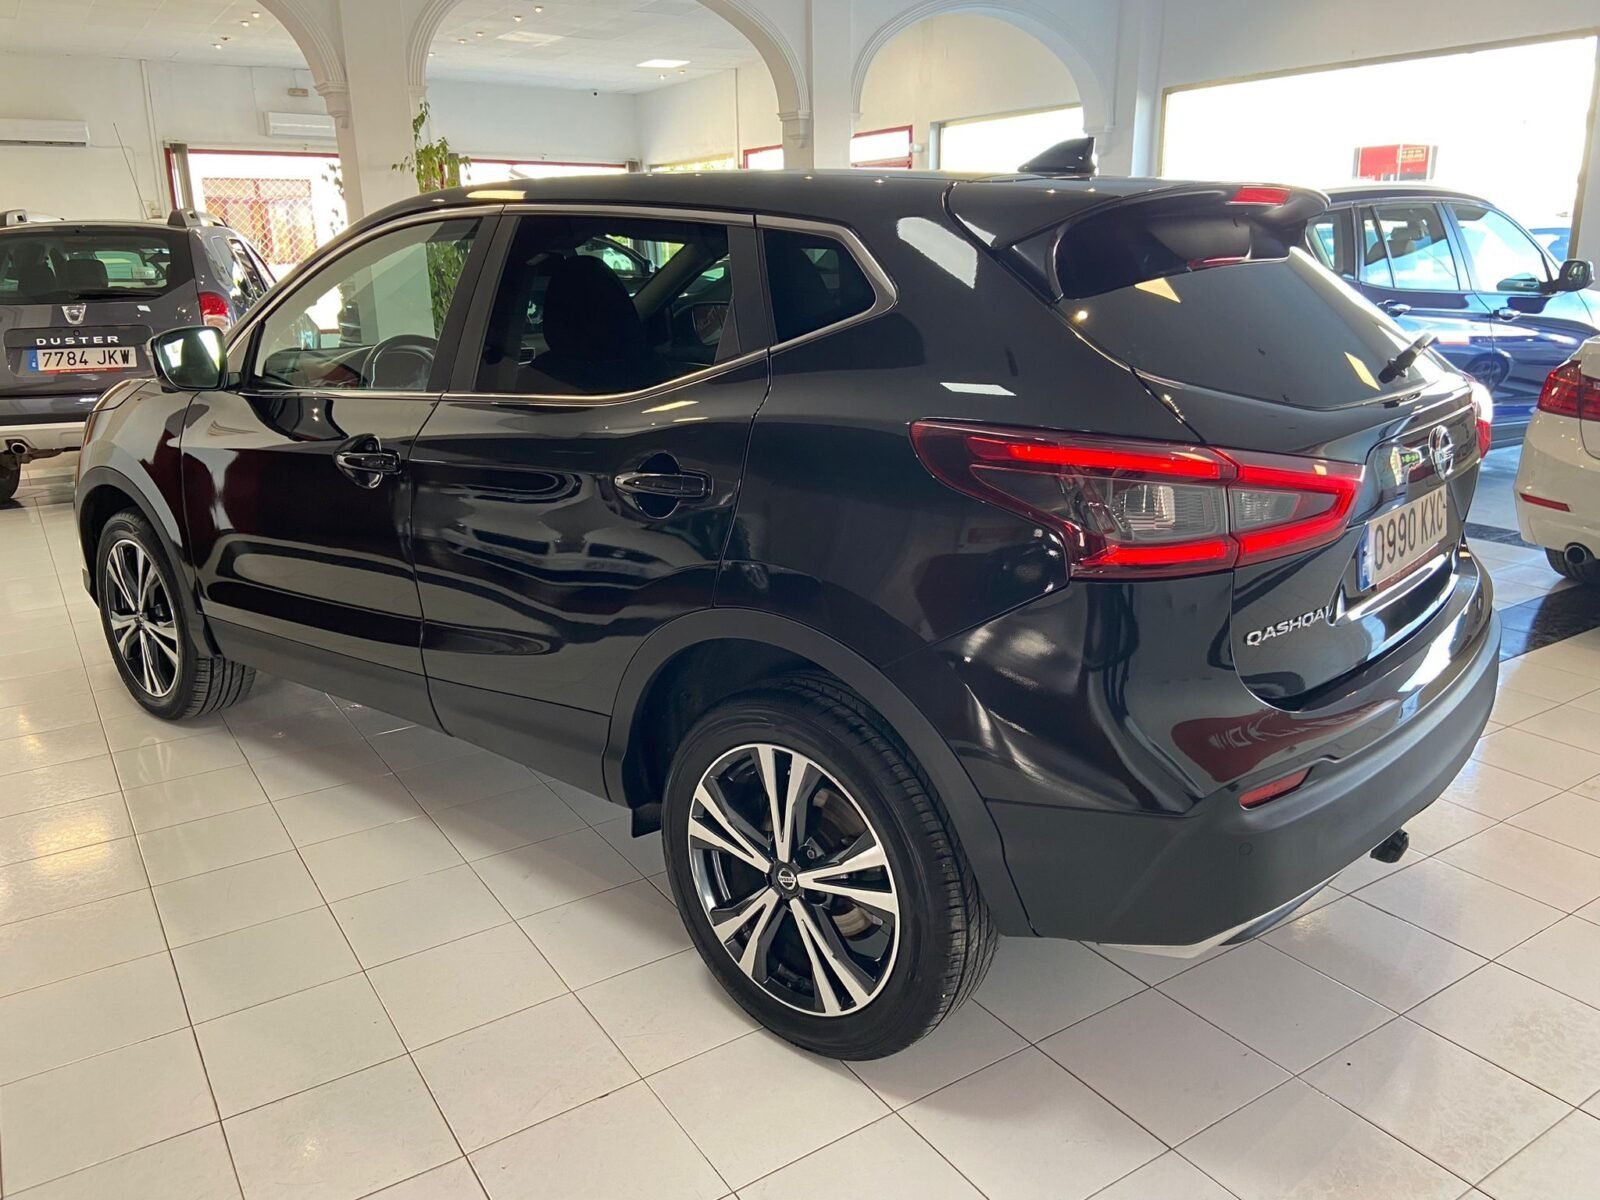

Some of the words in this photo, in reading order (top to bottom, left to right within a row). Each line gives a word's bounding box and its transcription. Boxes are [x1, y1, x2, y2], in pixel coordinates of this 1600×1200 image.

[36, 336, 119, 346] DUSTER
[42, 350, 88, 367] 7784
[97, 349, 130, 365] JKW
[1374, 507, 1416, 571] 0990
[1421, 490, 1443, 544] KXC
